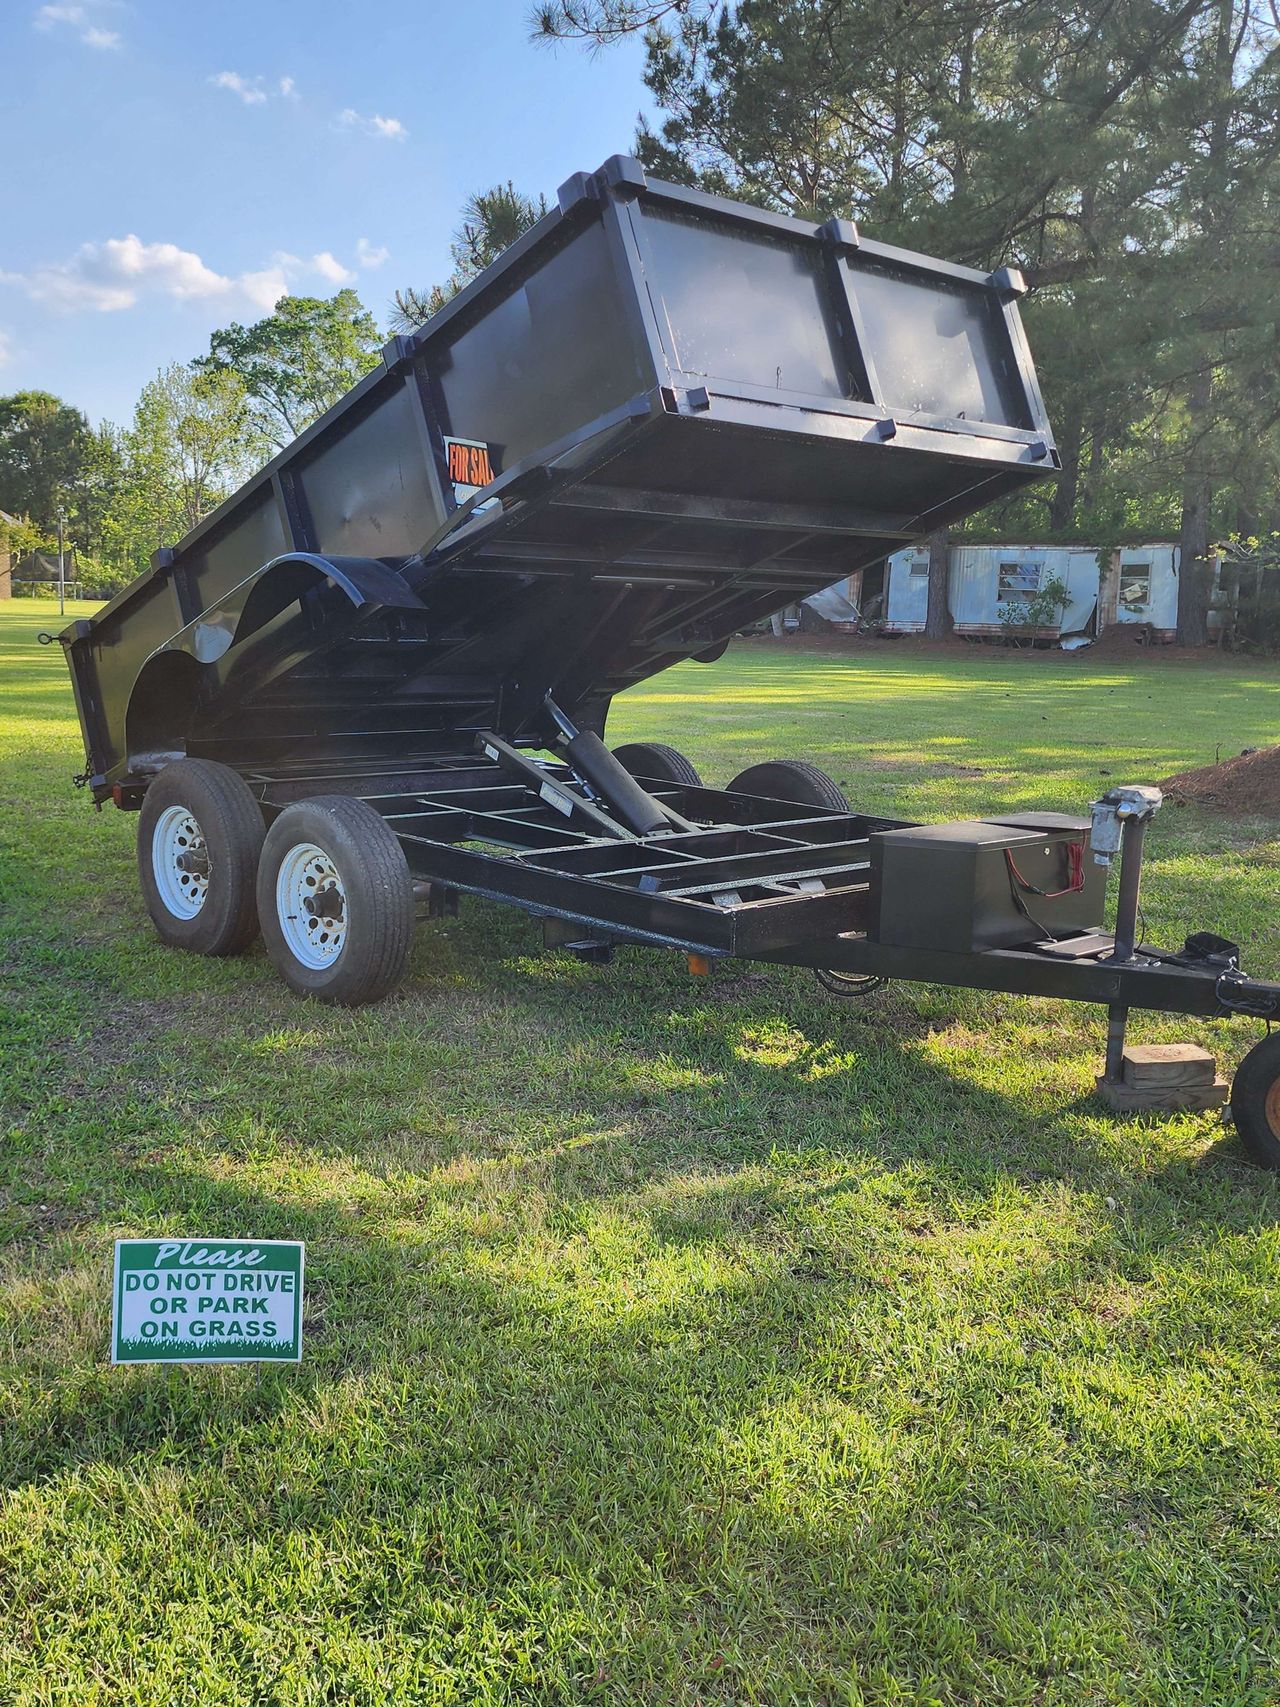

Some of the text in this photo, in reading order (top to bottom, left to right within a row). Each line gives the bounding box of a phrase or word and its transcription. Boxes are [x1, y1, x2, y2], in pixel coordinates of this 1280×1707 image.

[450, 444, 495, 486] FOR SAL
[154, 1243, 267, 1268] Please
[125, 1273, 294, 1293] DO NOT DRIVE
[150, 1297, 269, 1314] OR PARK
[140, 1320, 277, 1337] ON GRASS
